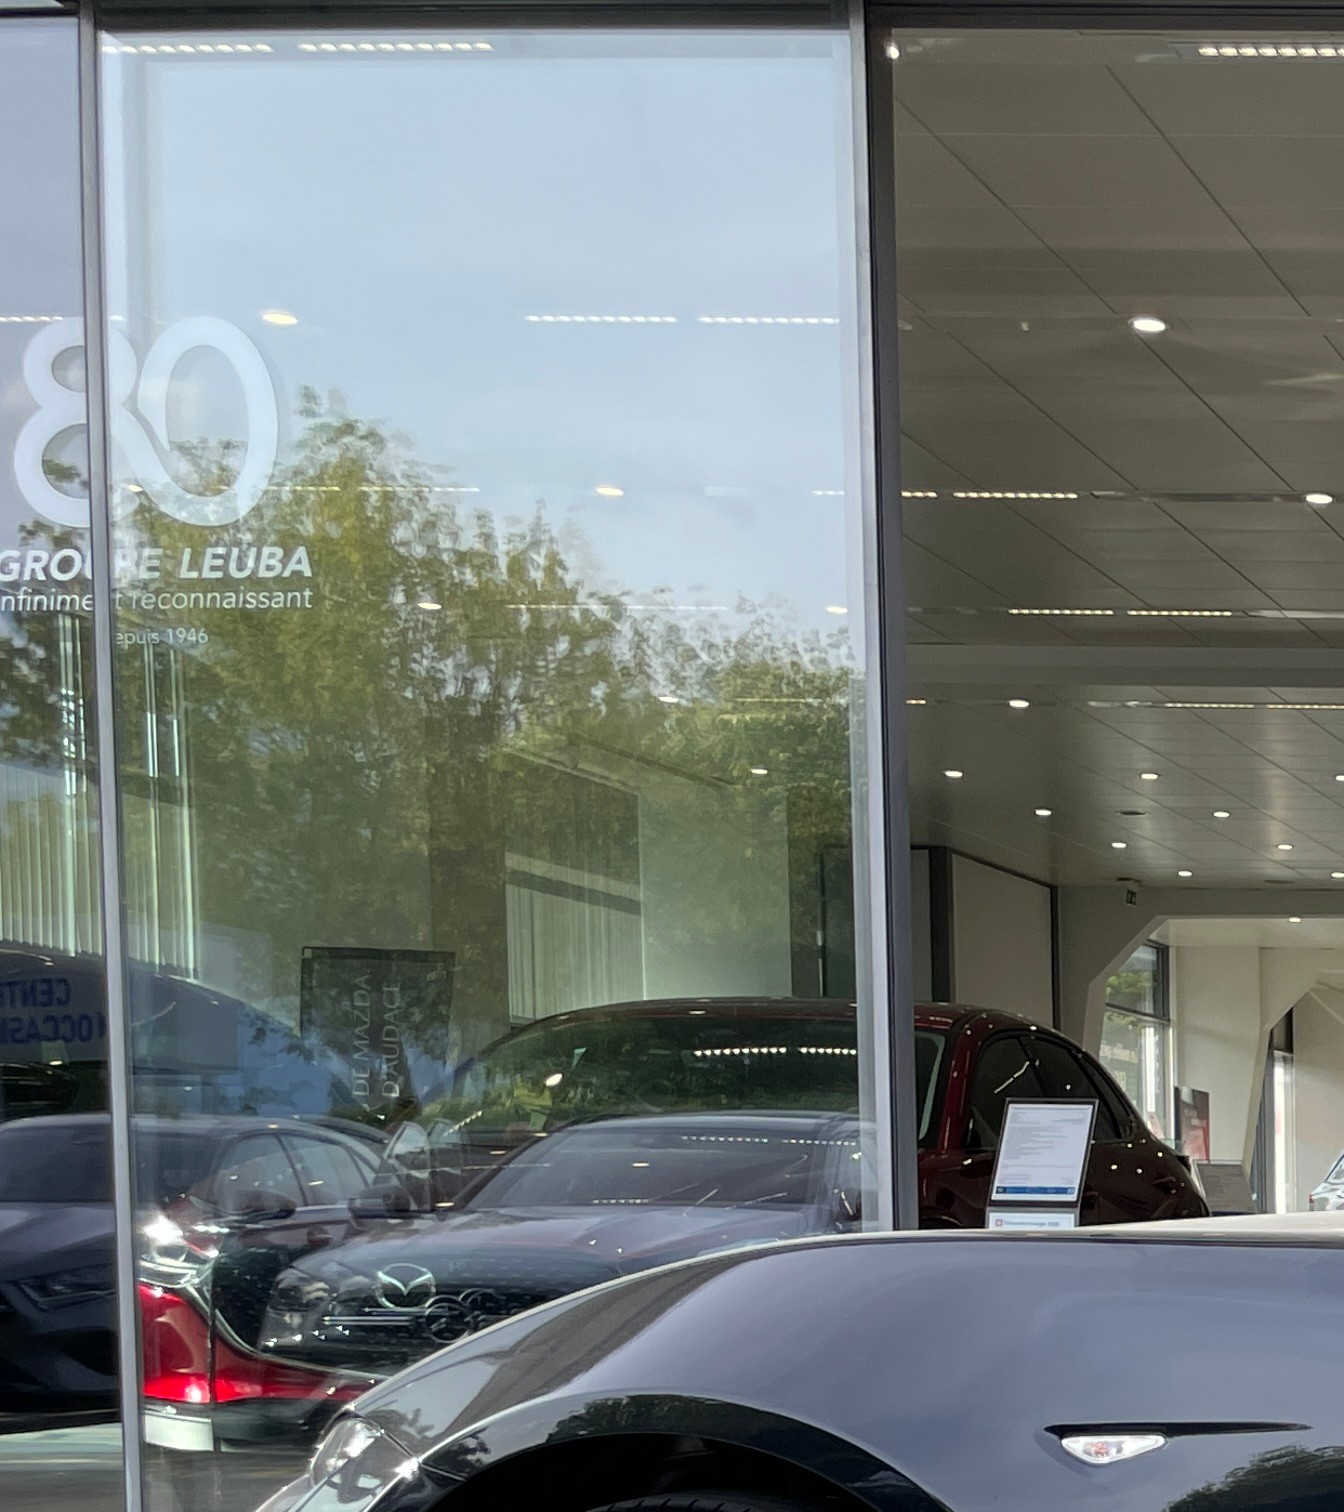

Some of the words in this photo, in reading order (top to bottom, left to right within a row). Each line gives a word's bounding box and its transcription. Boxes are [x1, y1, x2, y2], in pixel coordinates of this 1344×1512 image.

[14, 316, 278, 527] 80
[0, 548, 163, 581] GROPE
[179, 546, 313, 578] LEUBA
[132, 586, 313, 610] reconnaissant
[116, 629, 159, 647] epuis
[166, 628, 208, 644] 1946
[351, 974, 371, 1061] MAZDA
